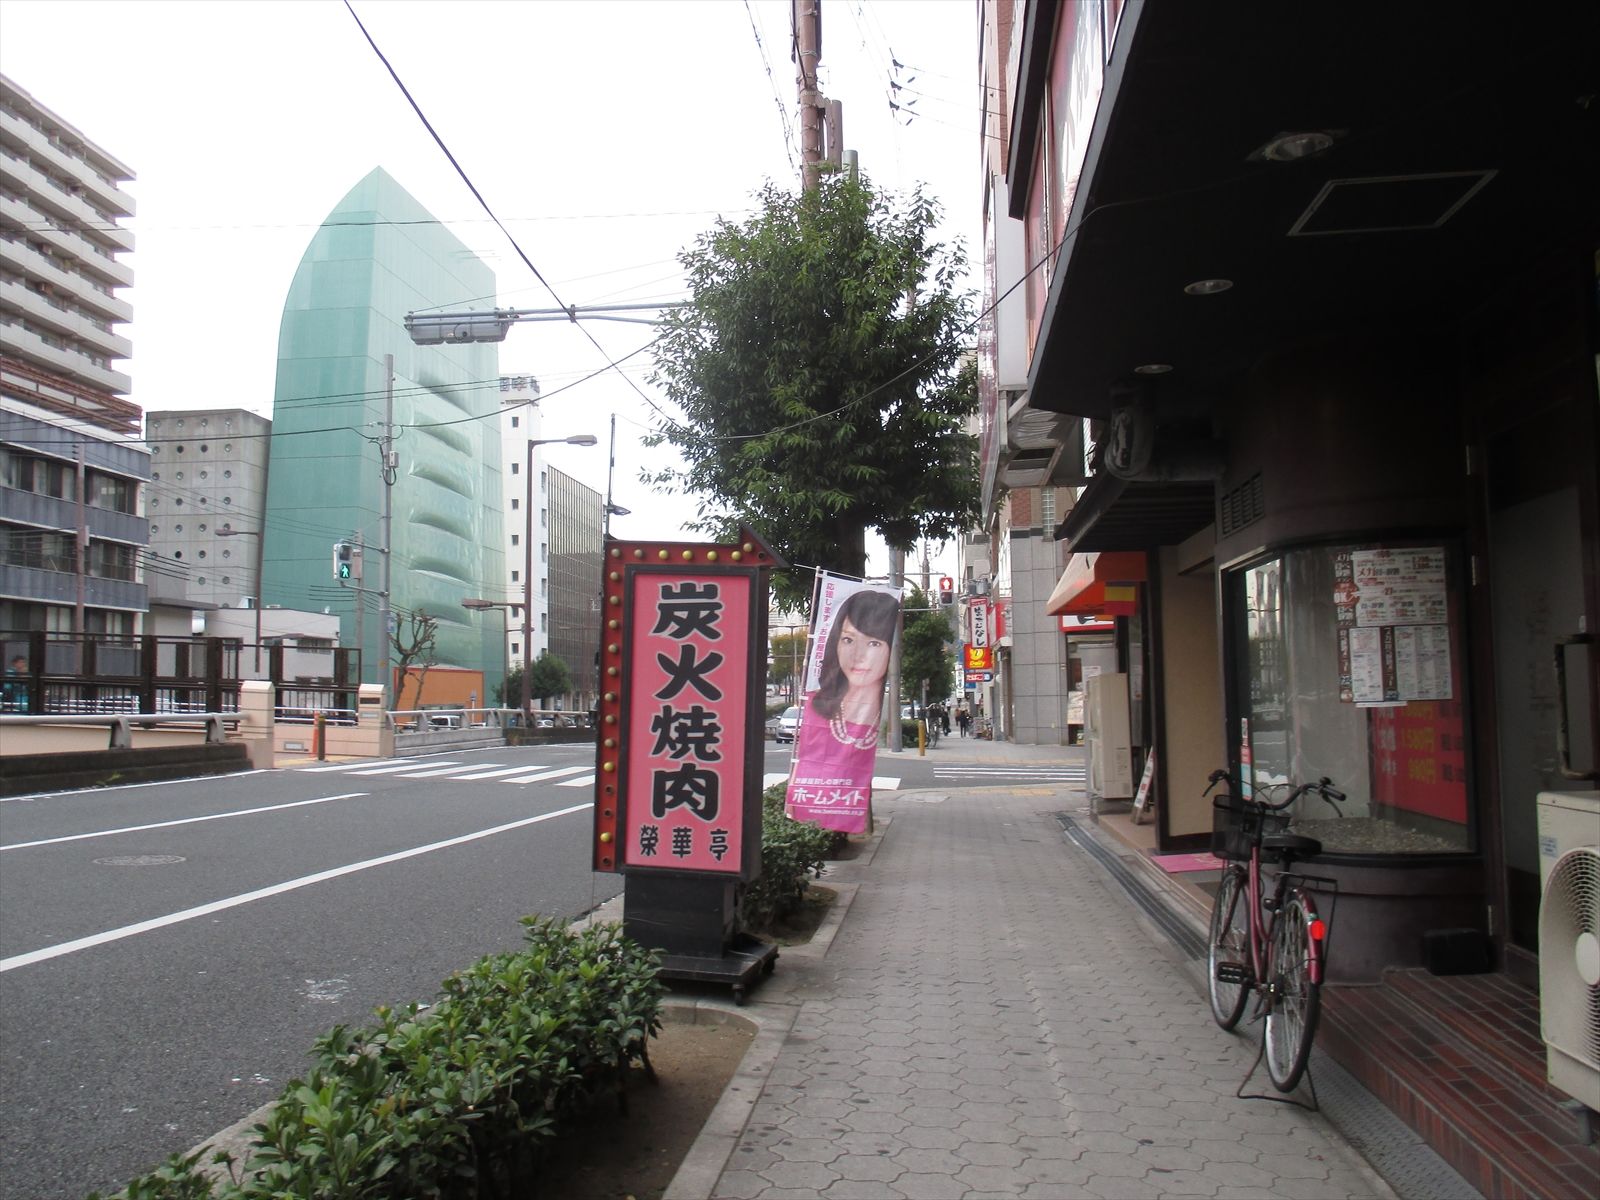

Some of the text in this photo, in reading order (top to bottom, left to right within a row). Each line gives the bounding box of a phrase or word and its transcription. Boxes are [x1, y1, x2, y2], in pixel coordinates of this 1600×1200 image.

[651, 581, 724, 822] 炭火焼肉
[792, 787, 864, 806] ホームメイト
